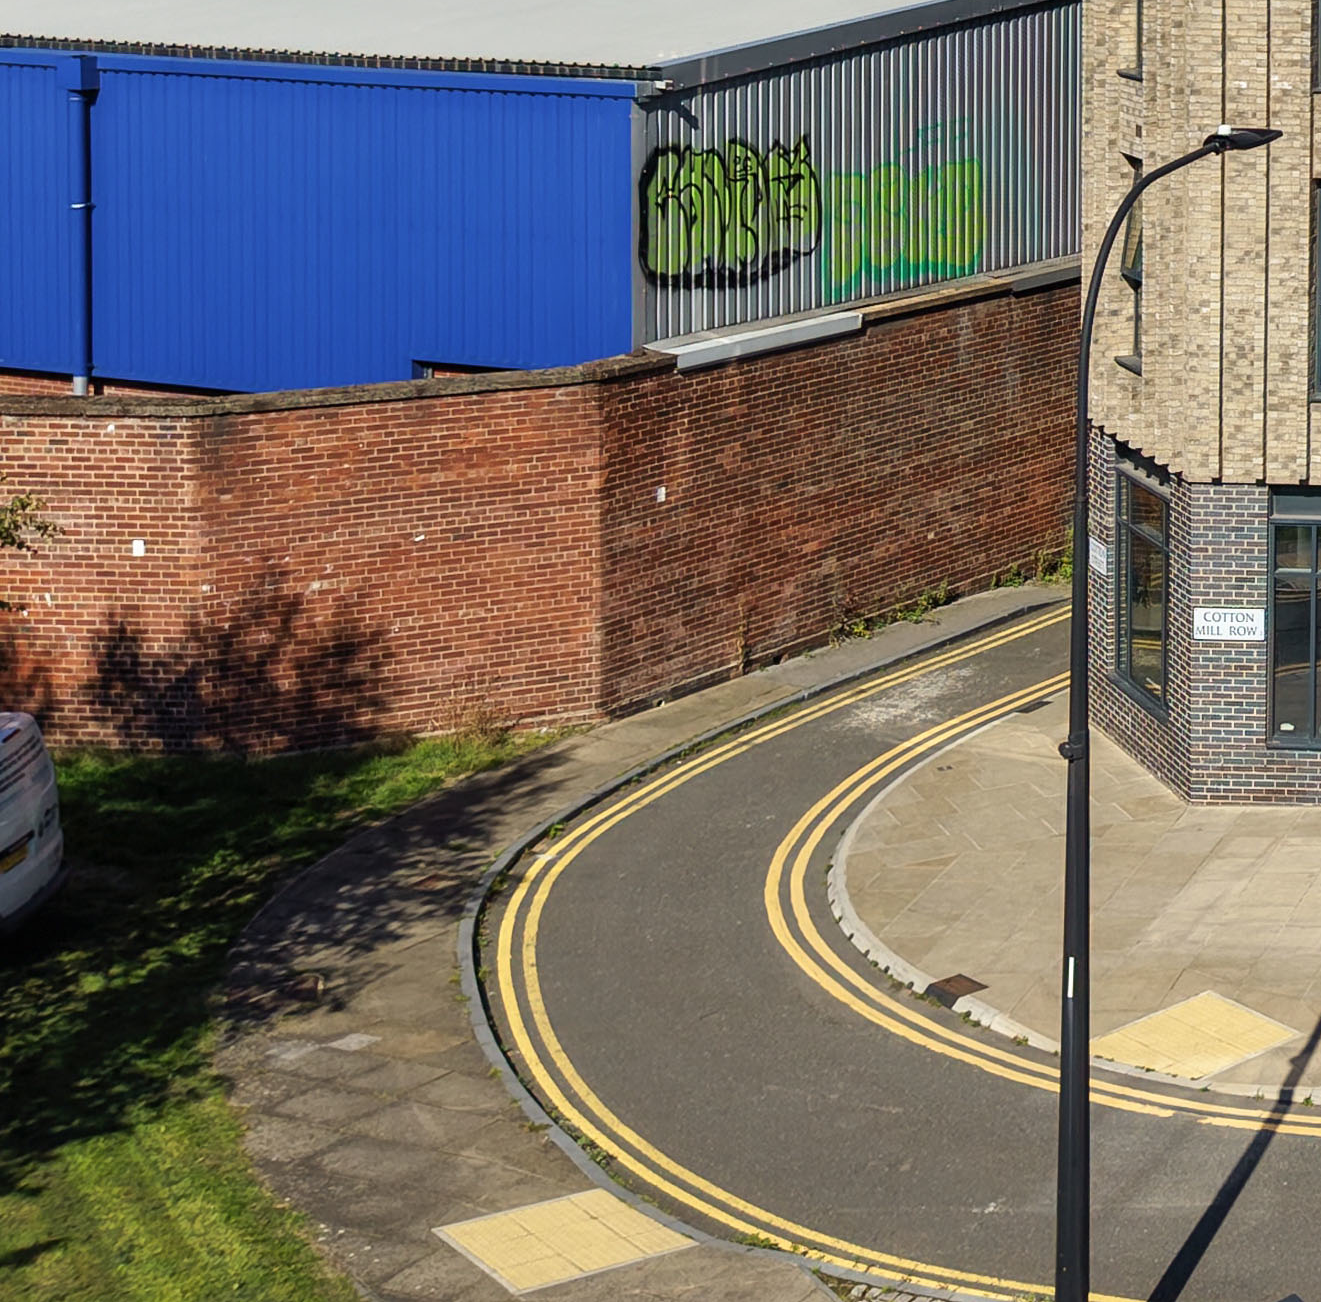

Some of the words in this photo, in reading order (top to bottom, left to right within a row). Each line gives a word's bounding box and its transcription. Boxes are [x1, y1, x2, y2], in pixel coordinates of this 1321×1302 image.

[1203, 611, 1254, 623] COTTON
[1195, 626, 1222, 636] MILL
[1229, 626, 1258, 636] ROW
